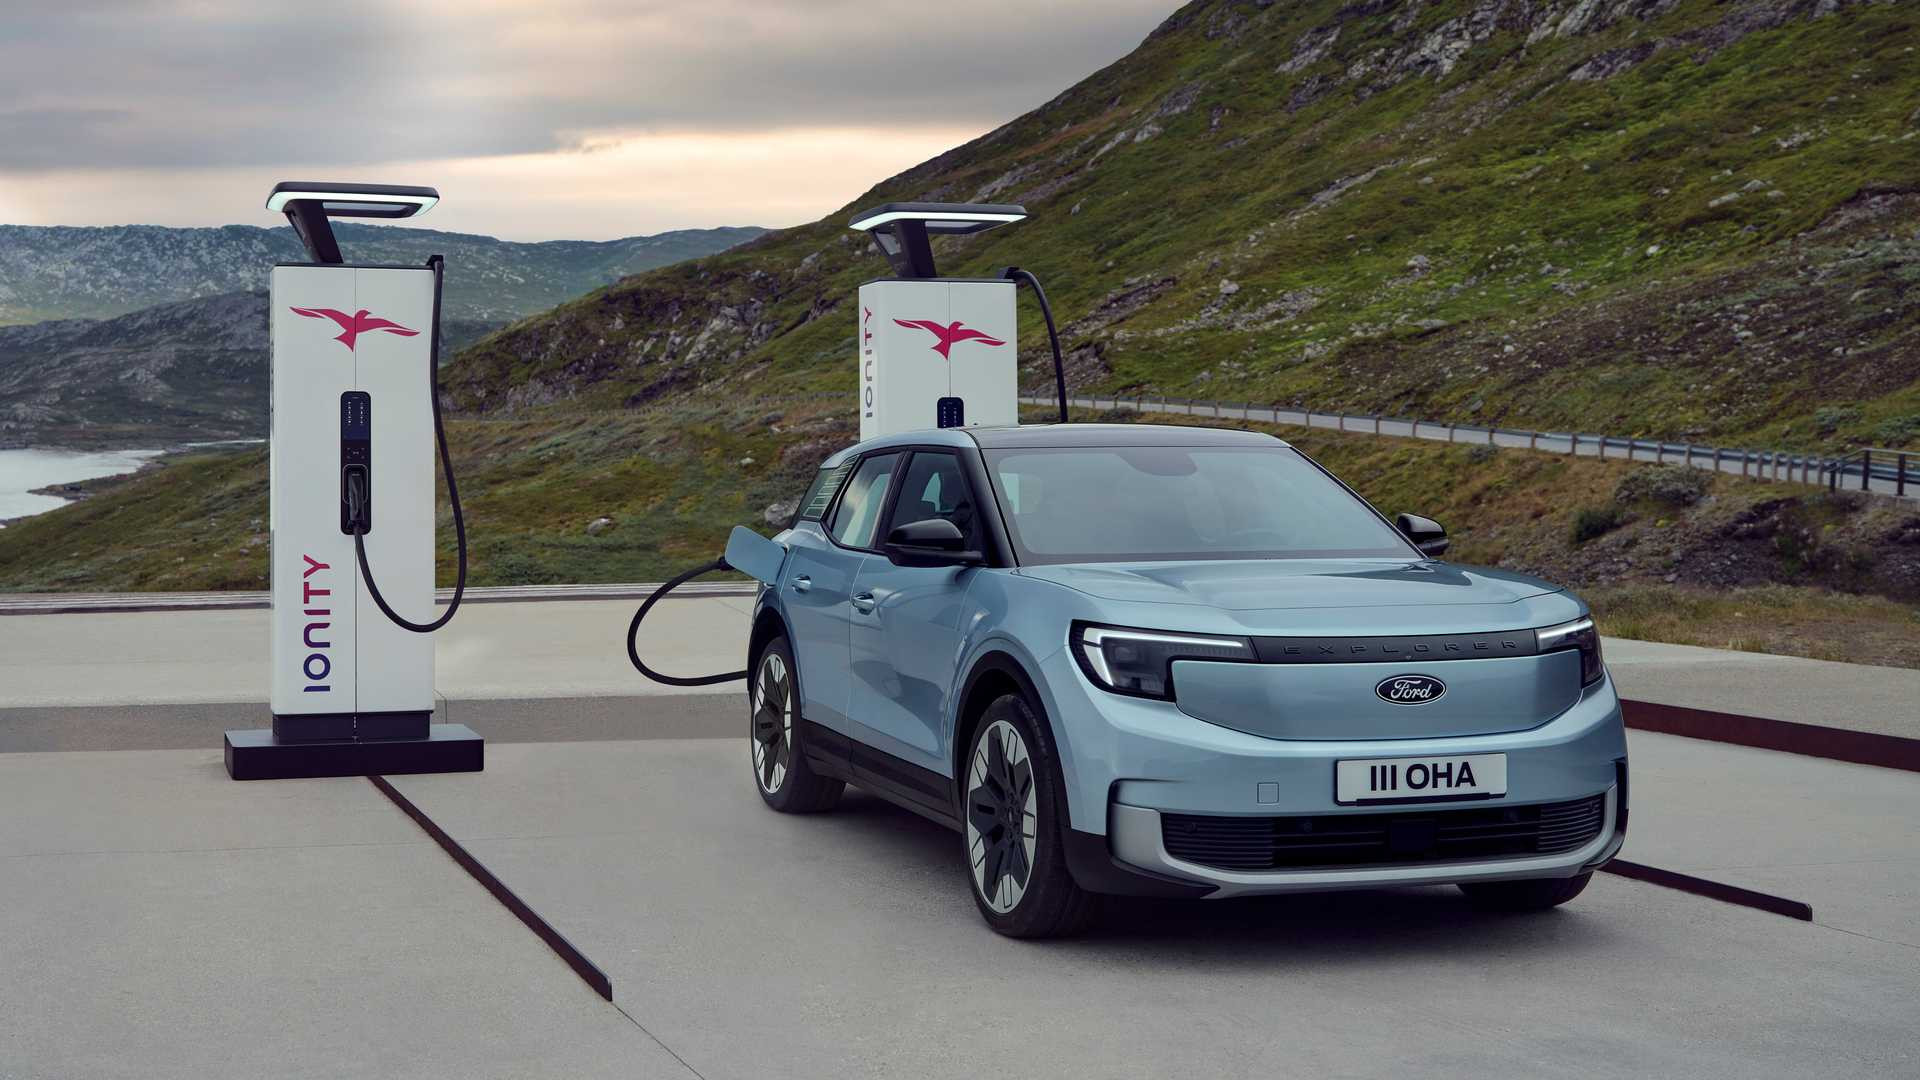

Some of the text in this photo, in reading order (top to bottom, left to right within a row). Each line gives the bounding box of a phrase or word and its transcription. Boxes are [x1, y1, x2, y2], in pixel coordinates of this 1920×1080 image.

[865, 306, 873, 418] IONITY
[303, 554, 331, 693] IONITY
[1283, 639, 1517, 655] EXPLORER
[1390, 679, 1433, 700] Ford
[1406, 761, 1477, 790] OHA
